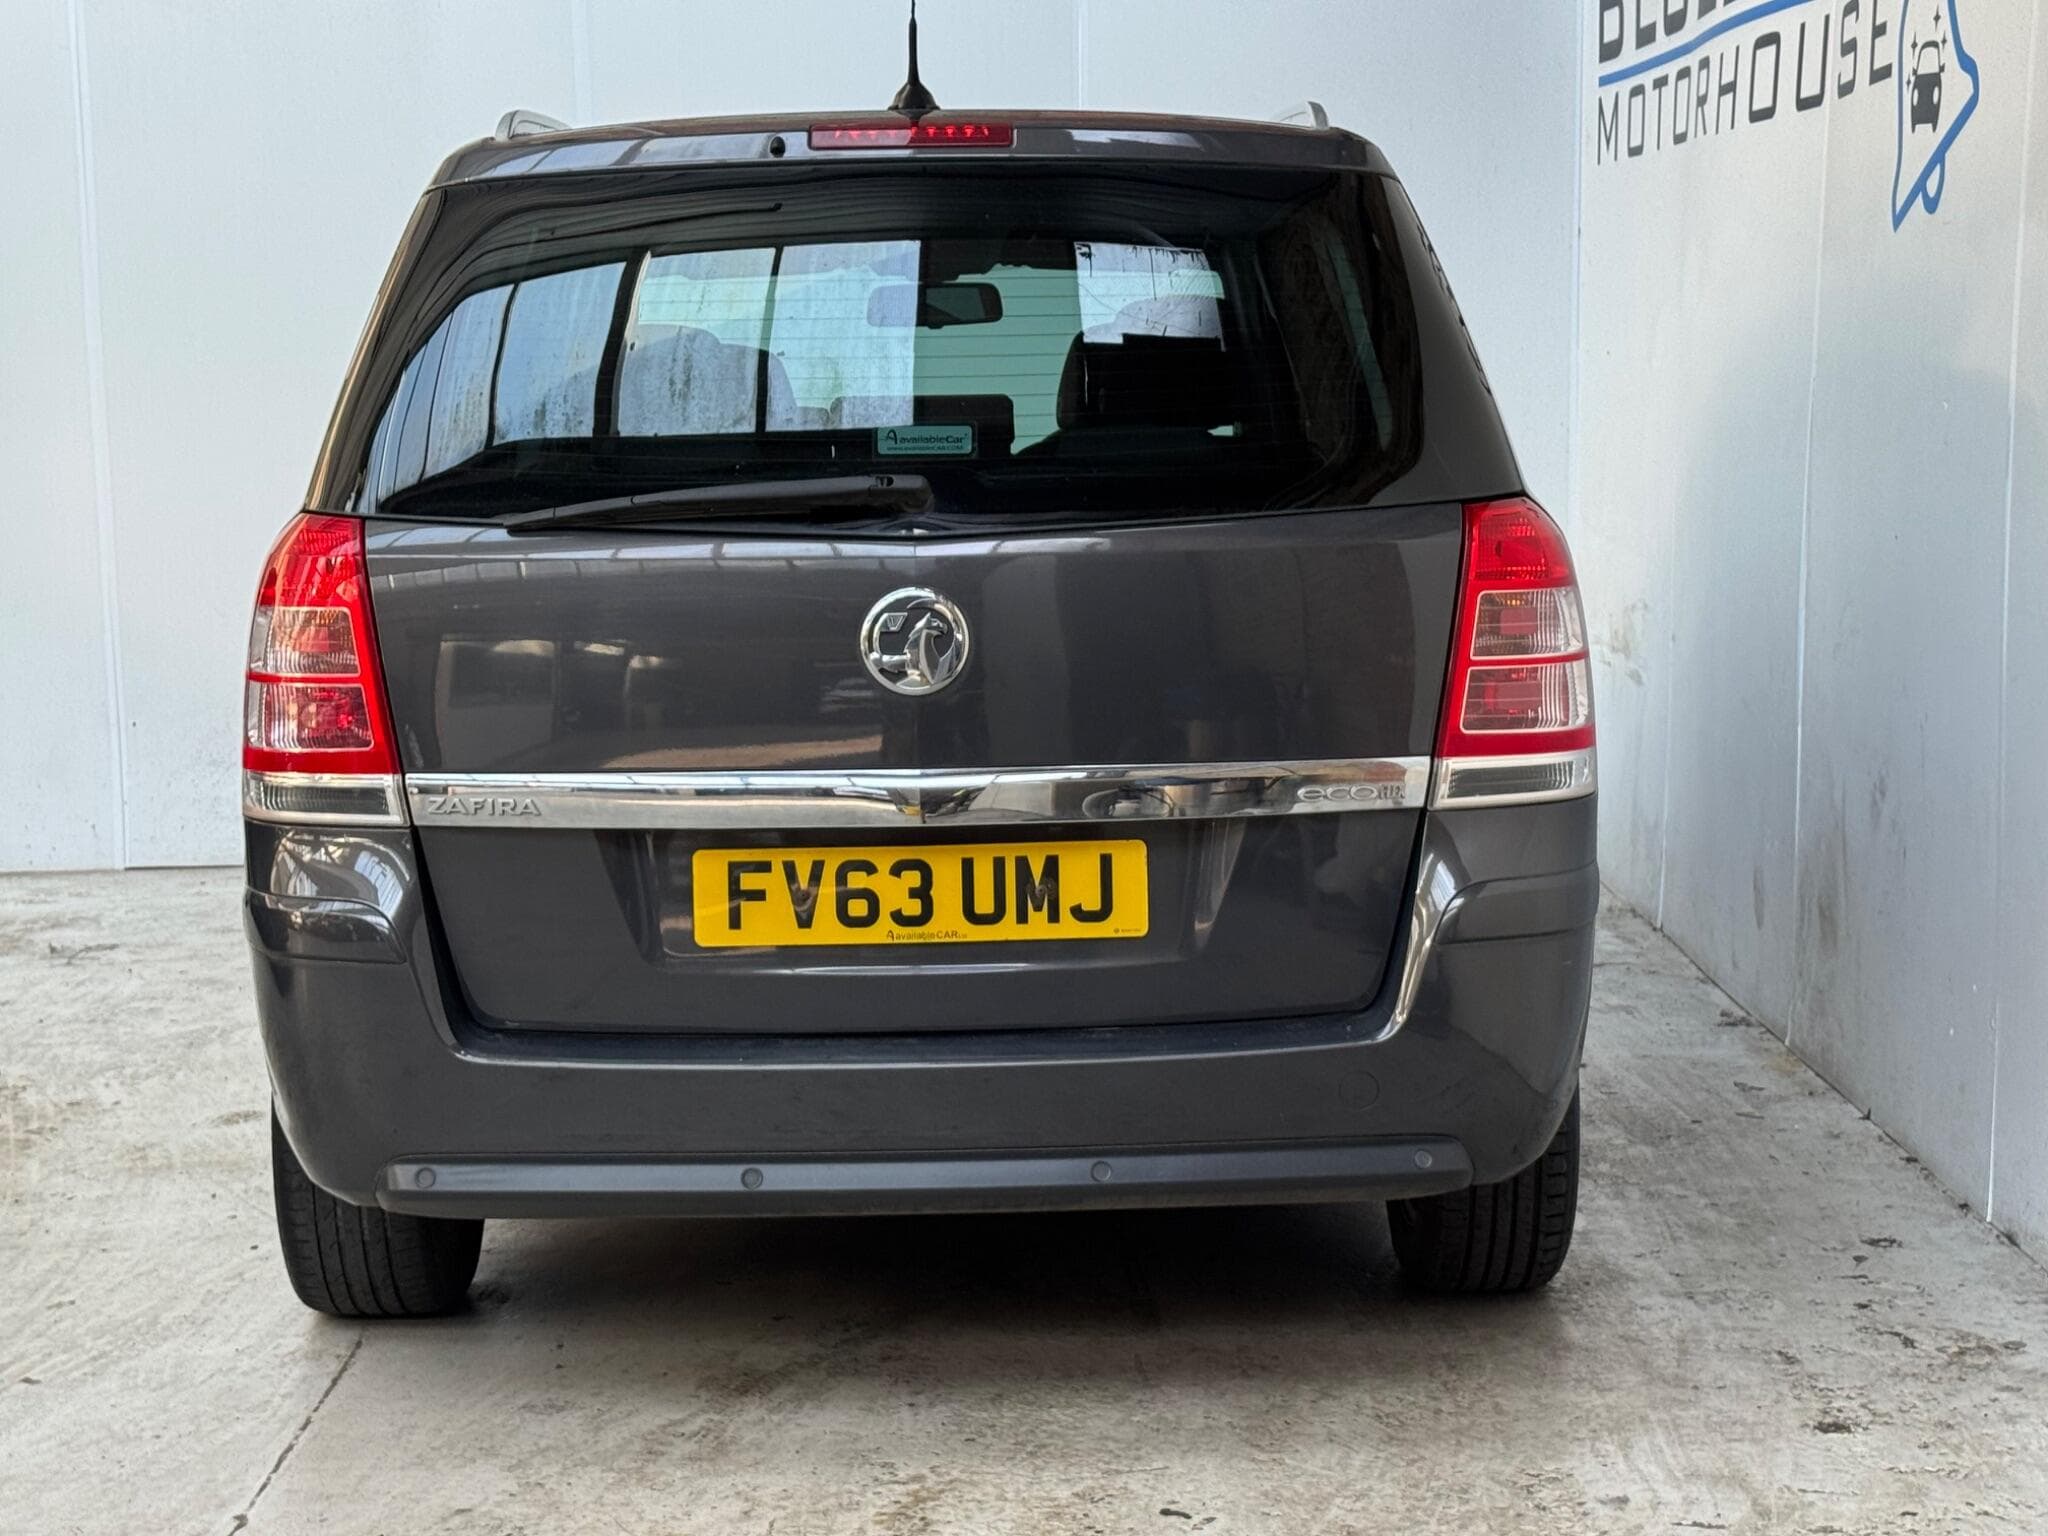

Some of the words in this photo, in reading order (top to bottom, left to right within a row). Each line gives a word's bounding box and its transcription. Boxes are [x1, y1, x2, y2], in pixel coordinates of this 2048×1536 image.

[1598, 0, 1893, 165] MOTORHOUSE
[428, 797, 541, 816] ZAFIRA
[727, 858, 934, 930] FV63
[961, 852, 1113, 925] UMJ
